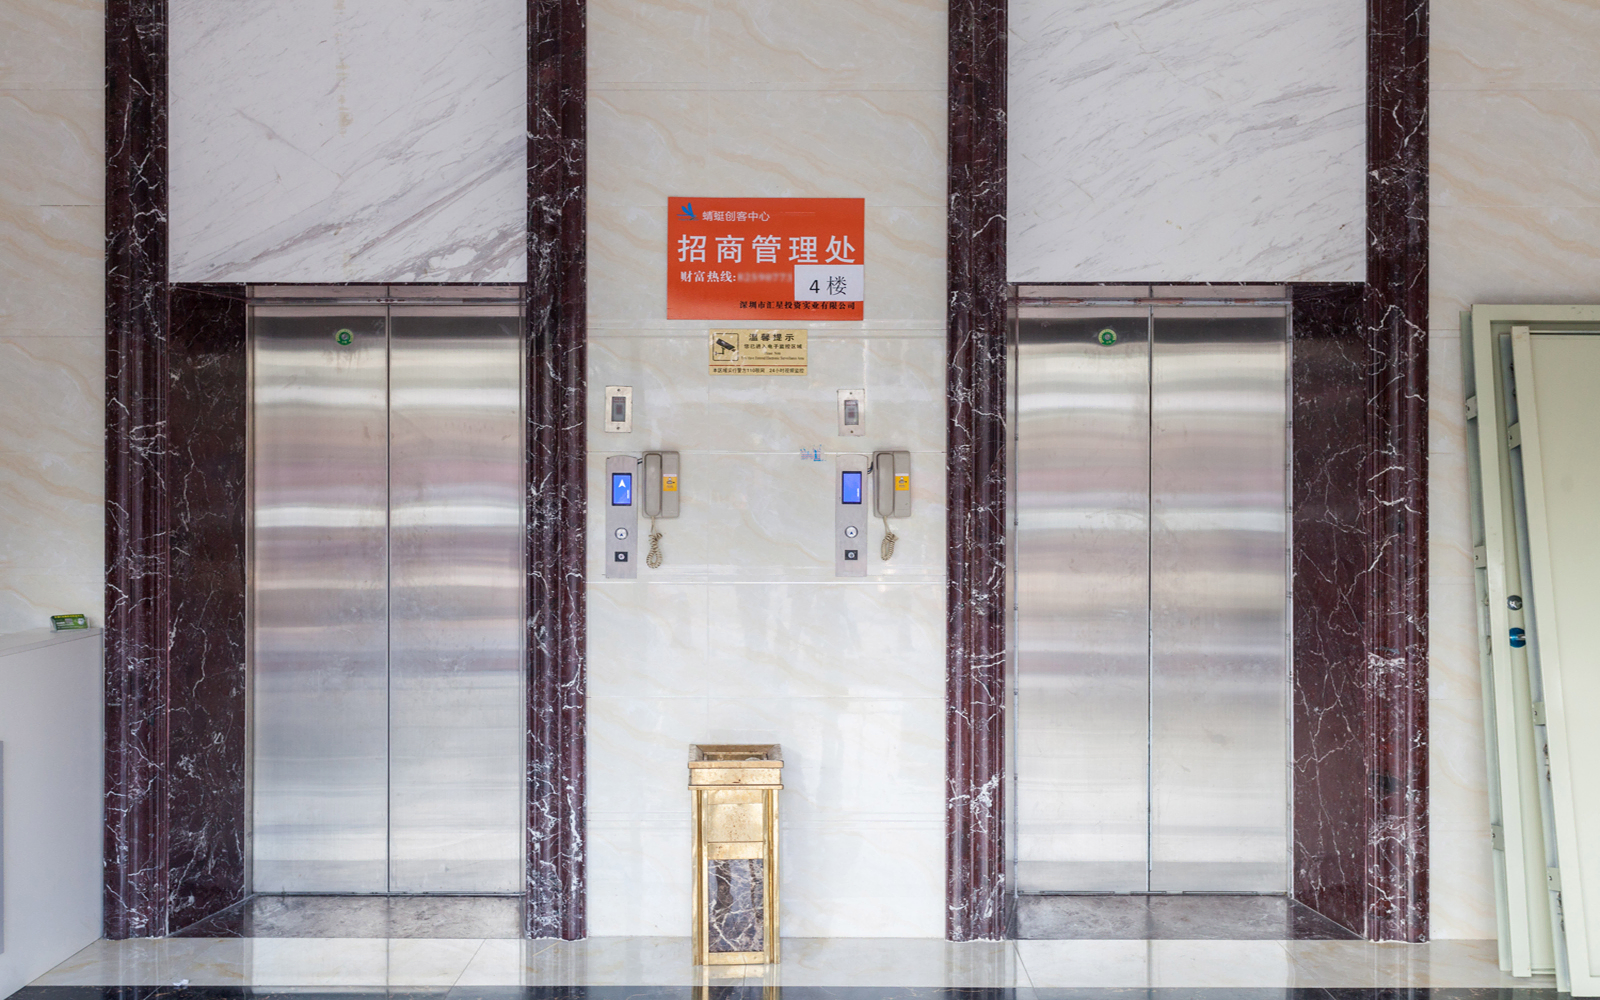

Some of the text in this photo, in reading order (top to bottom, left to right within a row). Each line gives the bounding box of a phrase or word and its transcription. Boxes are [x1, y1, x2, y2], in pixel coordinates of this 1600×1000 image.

[702, 210, 771, 222] 蜻蜓创客中心
[677, 234, 856, 264] 招商管理处
[739, 301, 856, 310] 深圳市汇星投资实业有限公司
[748, 333, 795, 342] 温馨提示
